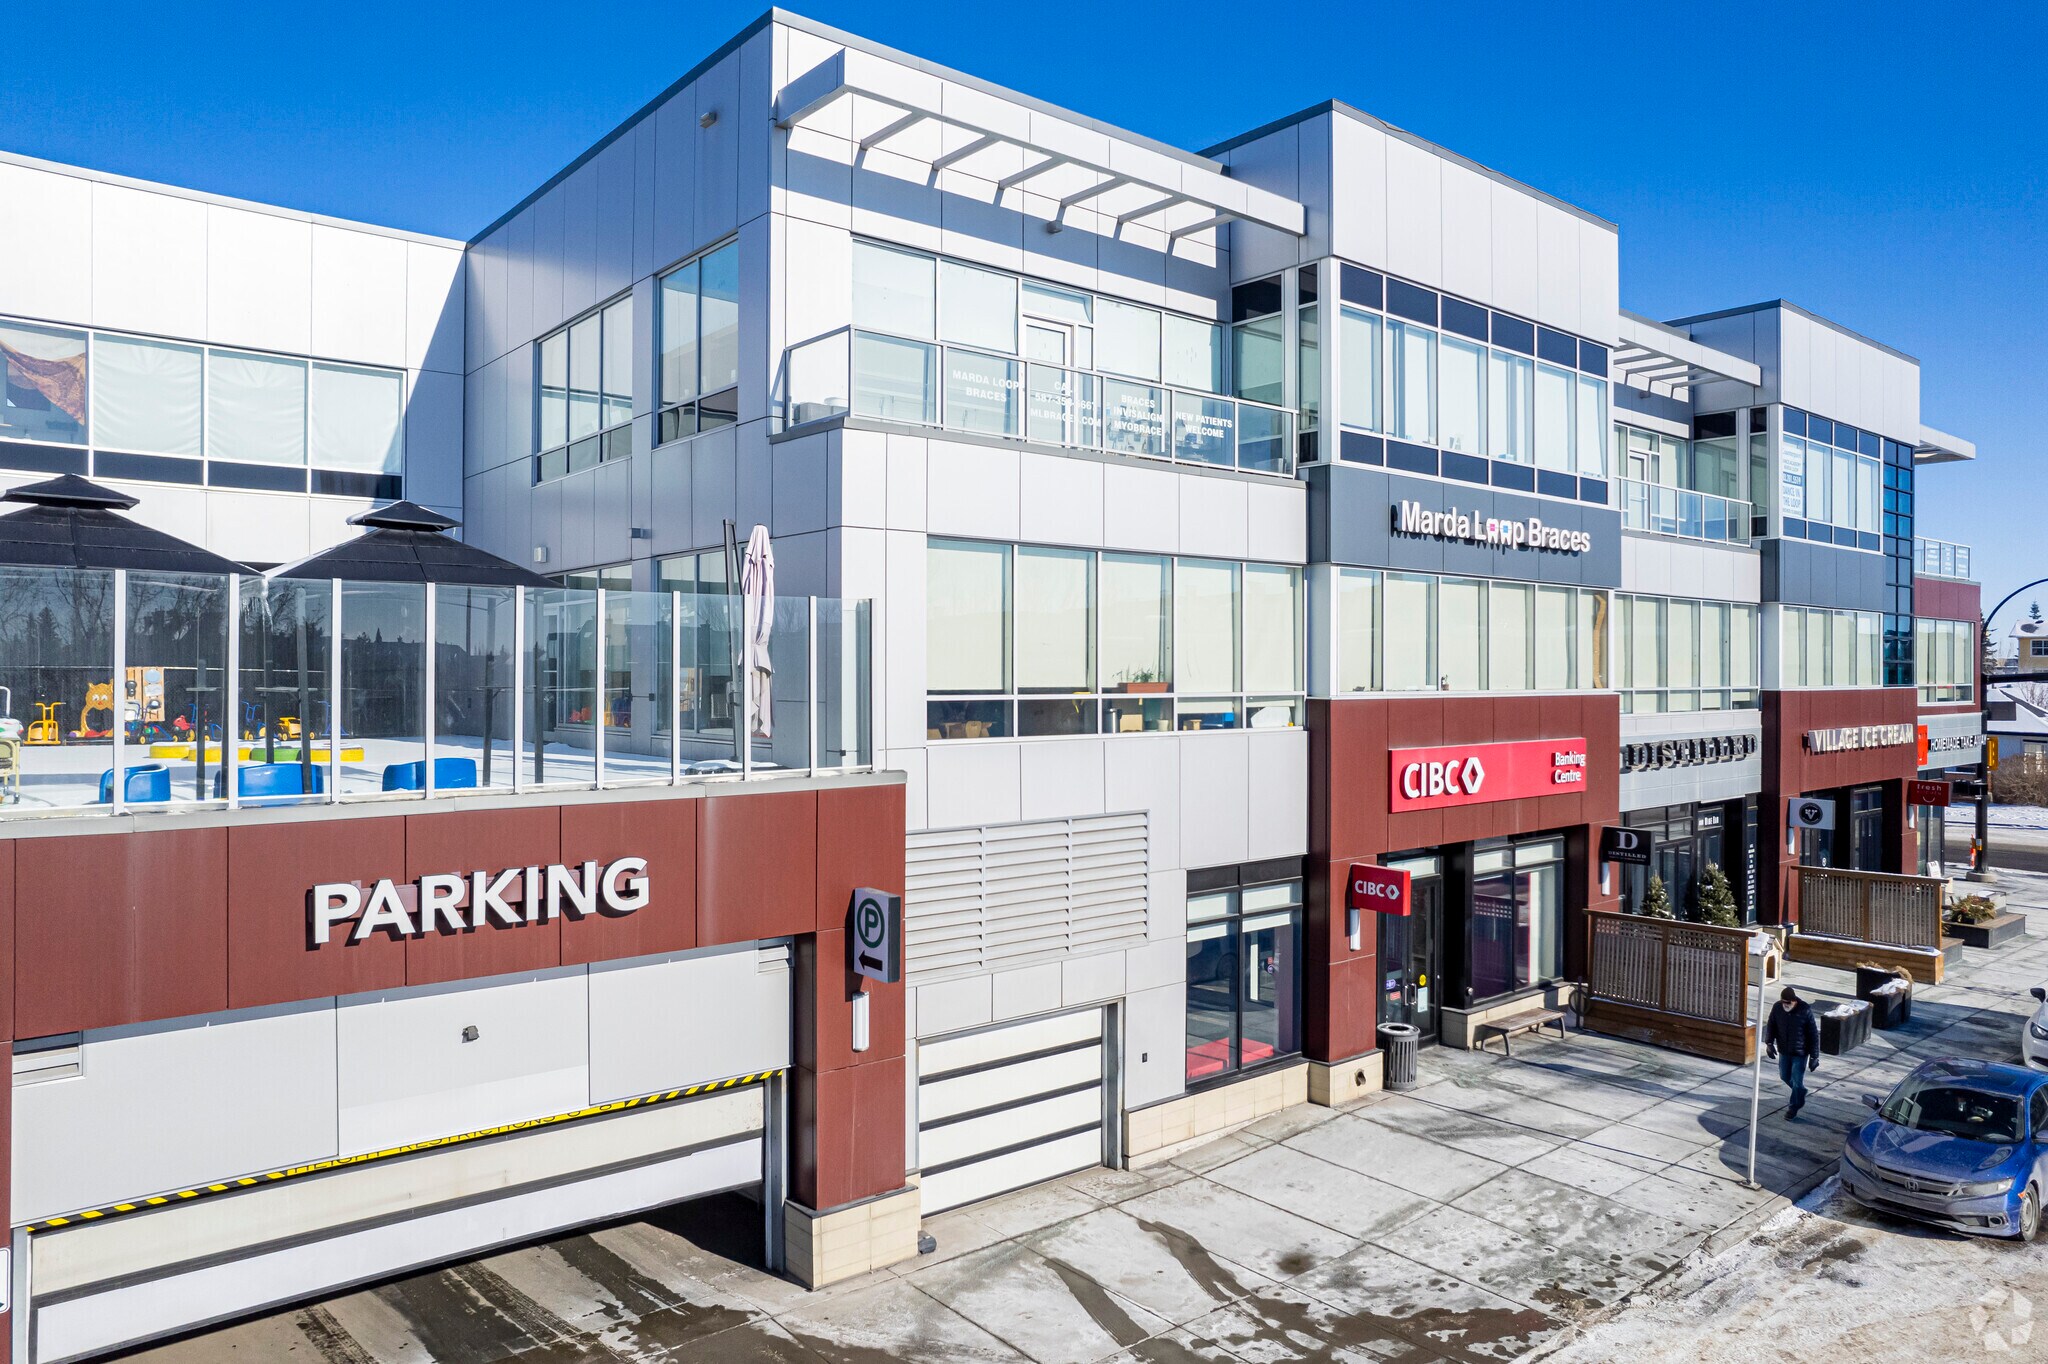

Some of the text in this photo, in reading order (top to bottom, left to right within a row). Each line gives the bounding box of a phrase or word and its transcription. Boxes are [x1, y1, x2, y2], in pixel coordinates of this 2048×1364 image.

[952, 370, 1020, 390] MARDA LOOP
[966, 387, 1007, 402] BRACES
[1121, 395, 1156, 409] BRACES
[1113, 406, 1163, 423] INVISALIGN
[1176, 411, 1233, 429] NEW PATIENTS
[1185, 424, 1224, 439] WELCOME
[1399, 500, 1592, 553] Marda Loop Braces
[1813, 724, 1914, 752] VILLAGE ICE CREAM
[1629, 734, 1758, 772] DISTILLED
[1402, 751, 1586, 800] CIBC Banking
[1554, 769, 1582, 785] Centre
[1916, 783, 1942, 792] fresh
[1616, 830, 1639, 850] D
[1608, 850, 1647, 860] DISTILLED
[1354, 879, 1385, 898] CIBC
[312, 855, 651, 945] PARKING
[864, 907, 879, 938] P
